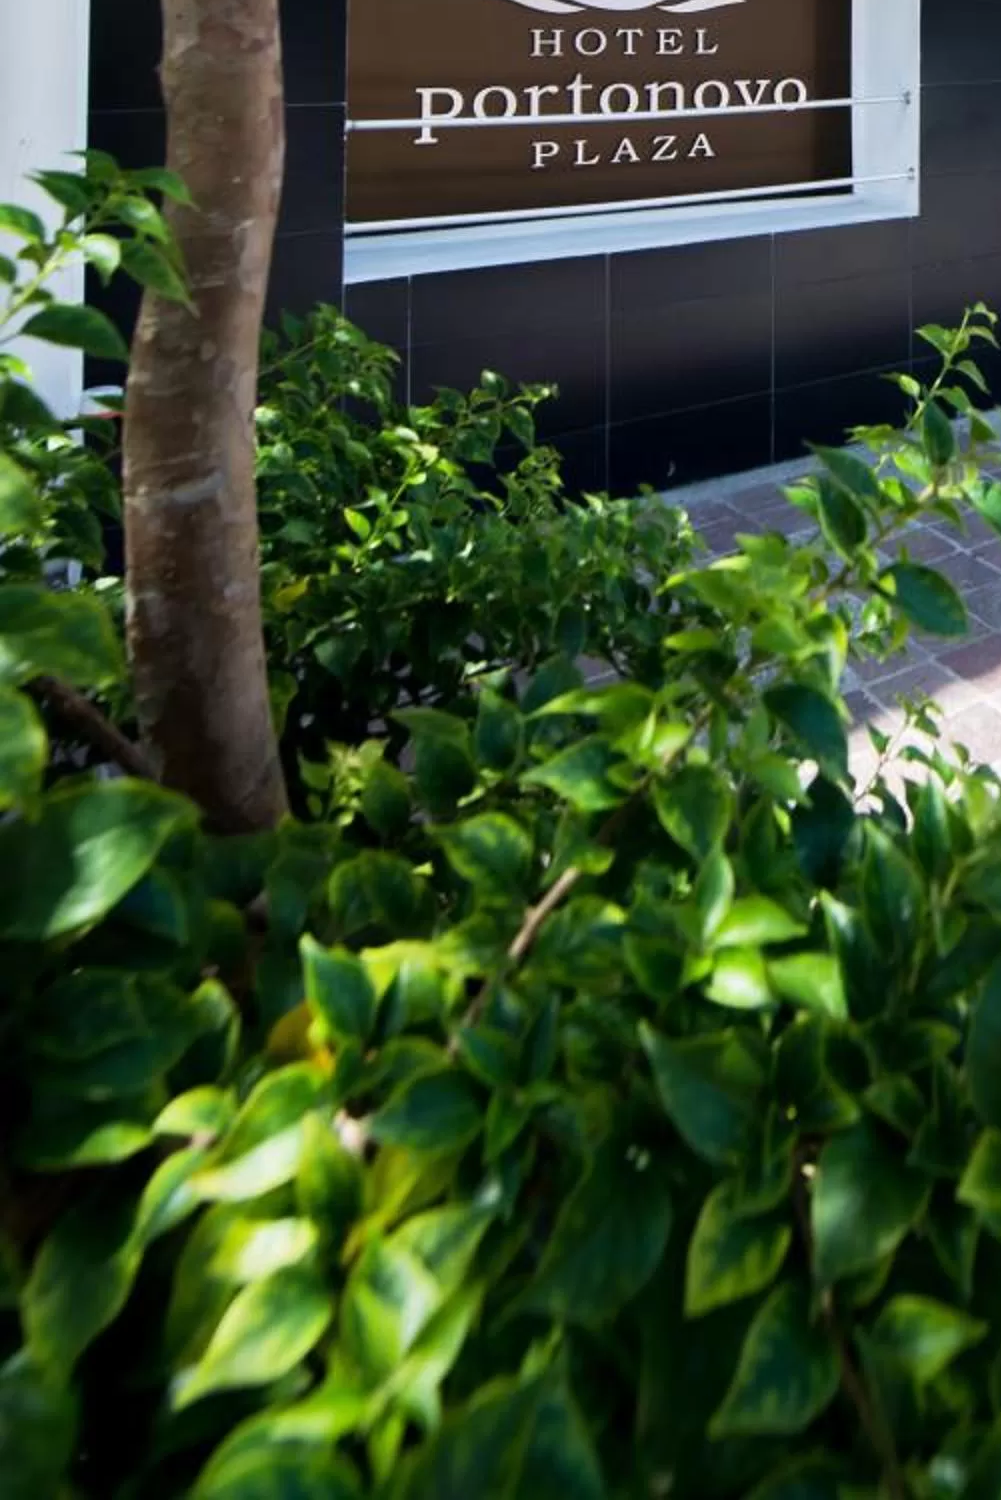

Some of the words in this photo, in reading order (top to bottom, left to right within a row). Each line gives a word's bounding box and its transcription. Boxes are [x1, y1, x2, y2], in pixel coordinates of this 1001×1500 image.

[529, 28, 720, 58] HOTEL
[413, 72, 808, 145] portonovo
[530, 133, 717, 169] PLAZA
